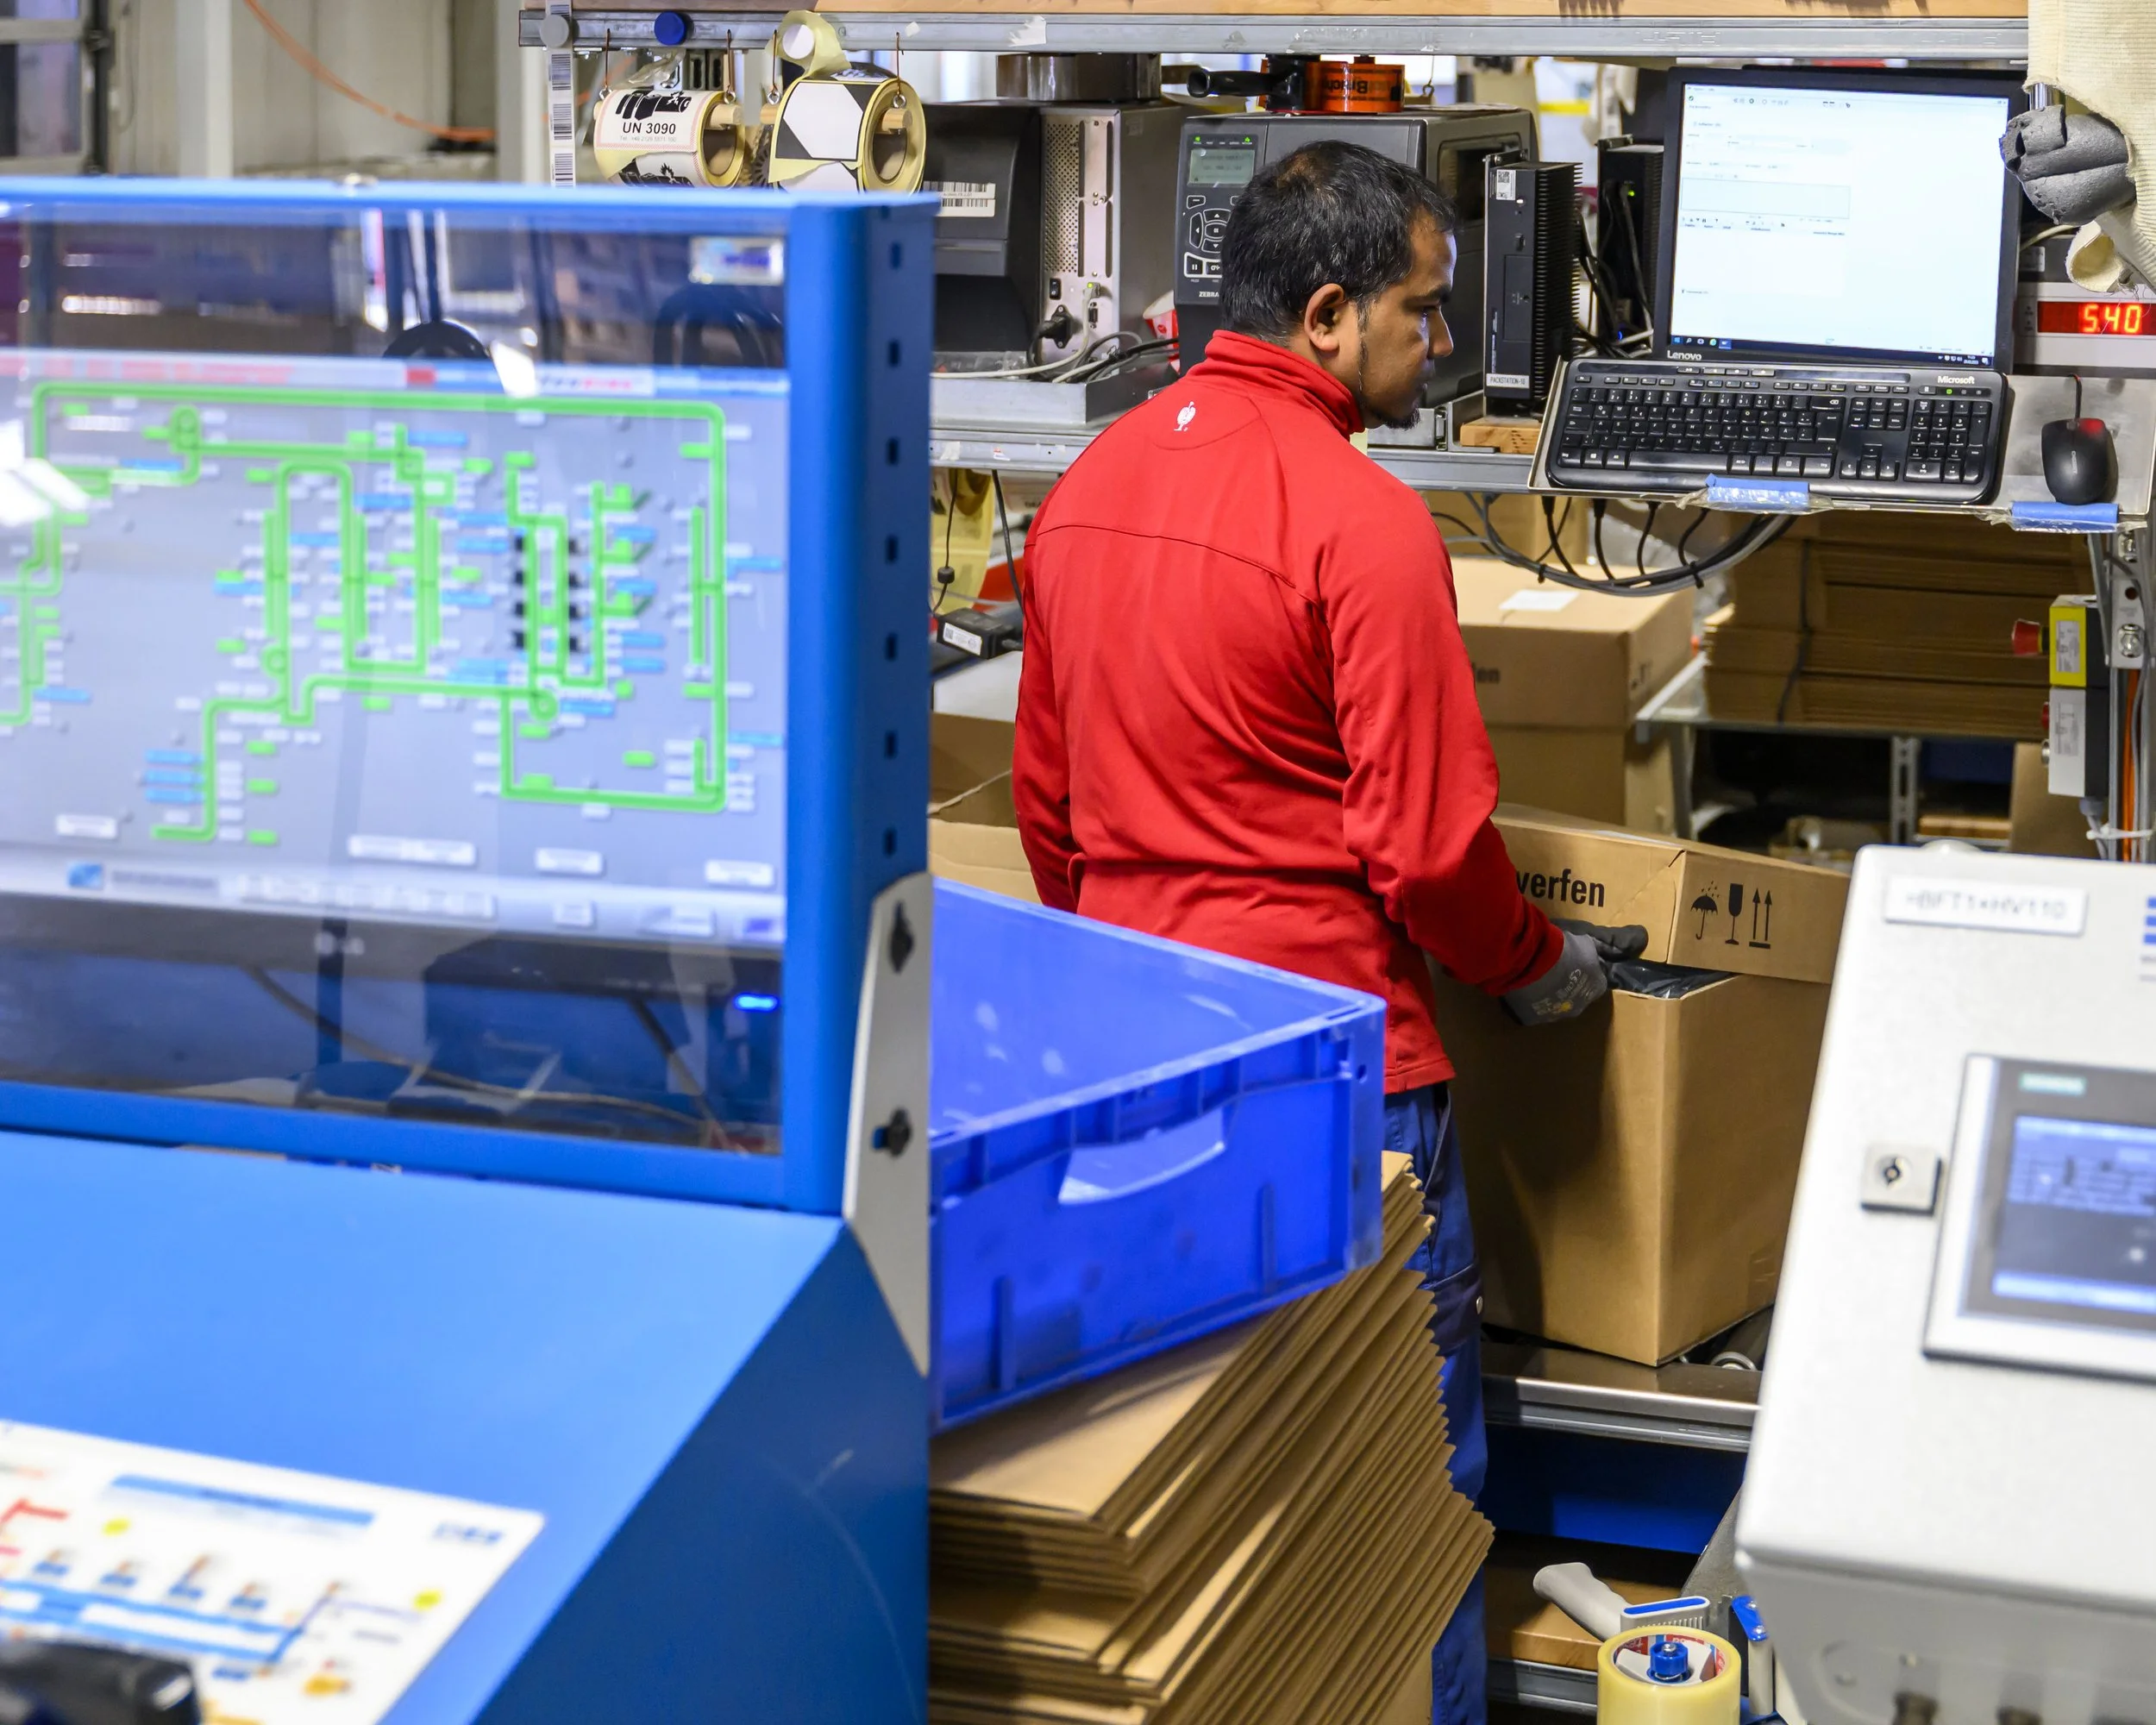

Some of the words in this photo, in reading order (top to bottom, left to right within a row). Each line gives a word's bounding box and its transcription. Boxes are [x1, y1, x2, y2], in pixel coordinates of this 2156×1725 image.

[623, 122, 642, 134] UN
[646, 123, 676, 135] 3090
[1667, 349, 1702, 361] Lenovo
[1937, 375, 1975, 385] Microsoft
